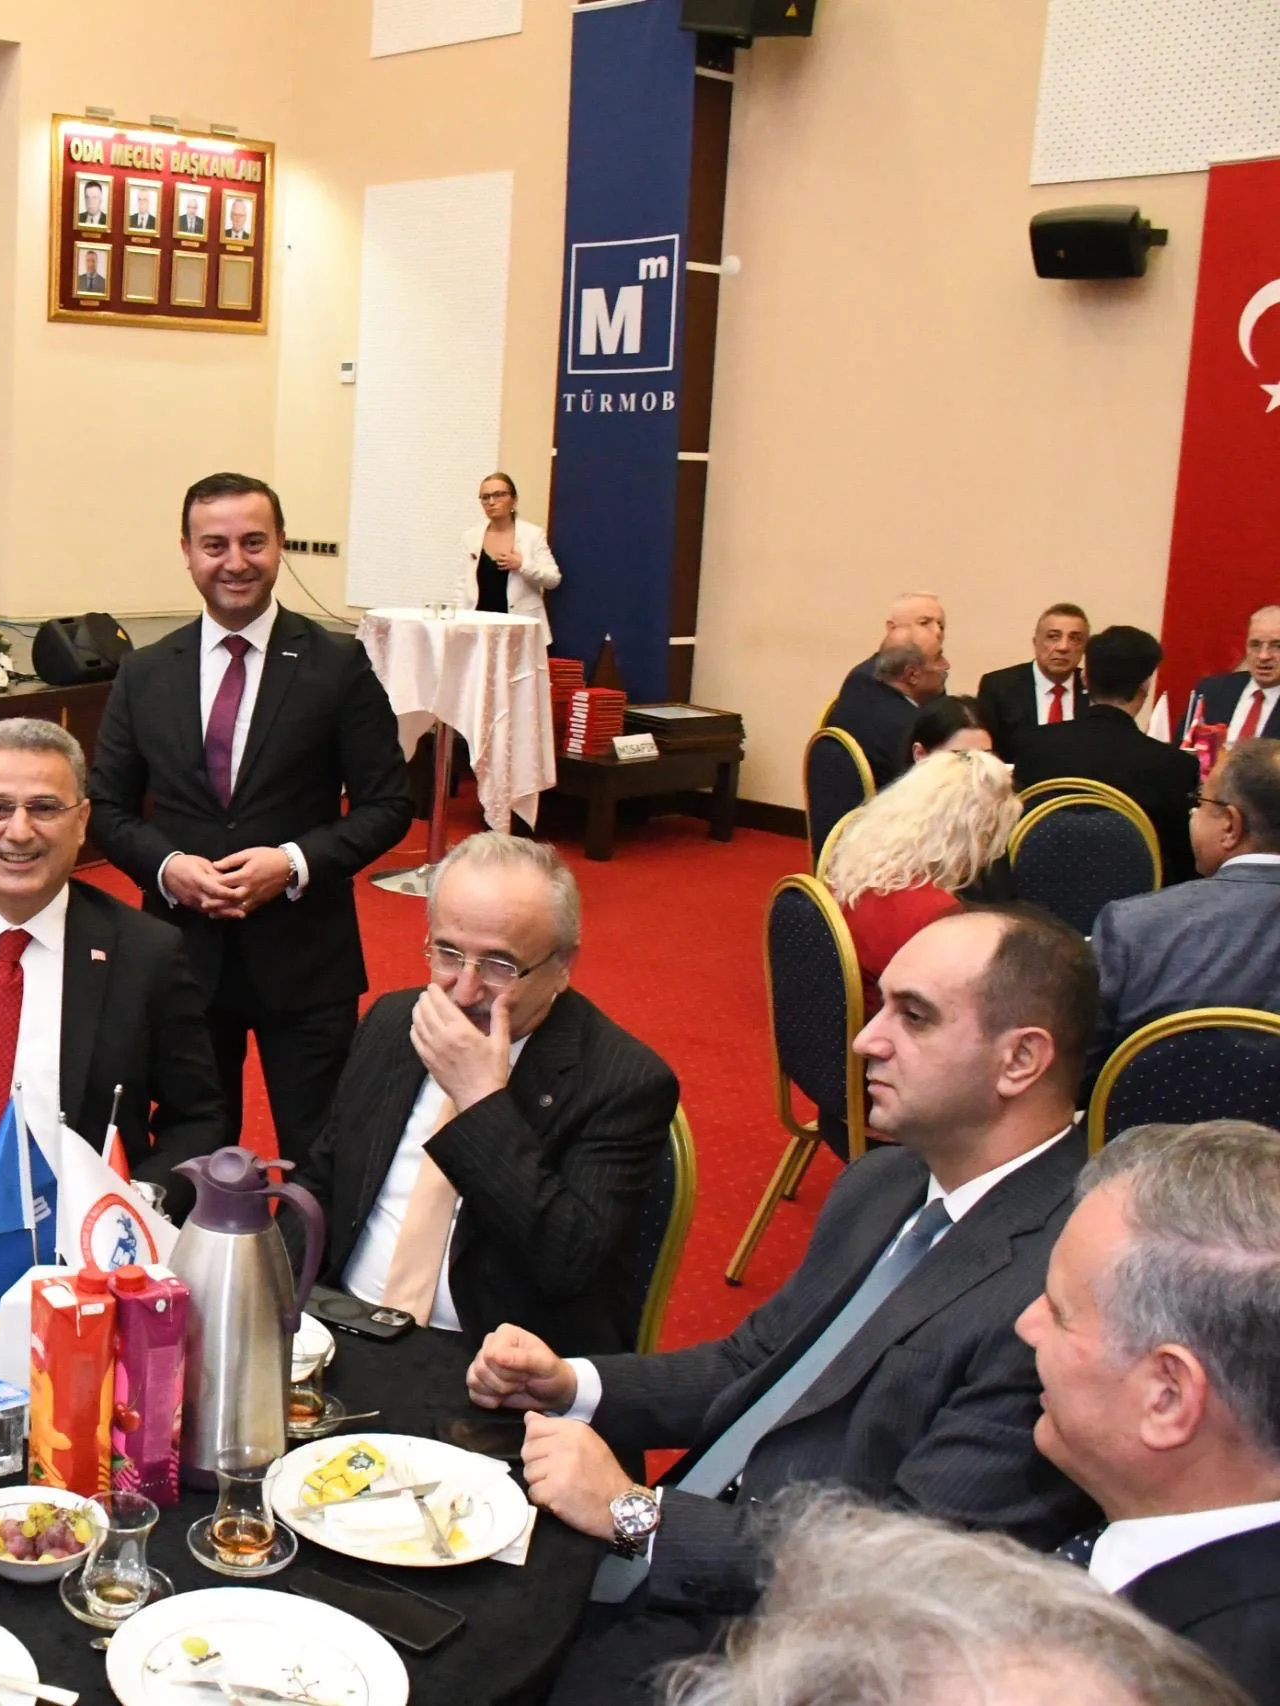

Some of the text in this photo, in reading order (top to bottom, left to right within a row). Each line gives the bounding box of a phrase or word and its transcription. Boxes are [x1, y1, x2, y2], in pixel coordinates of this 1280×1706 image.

[70, 136, 262, 183] ODA MECLİS BAŞKANLARI
[563, 388, 676, 414] TÜRMOB
